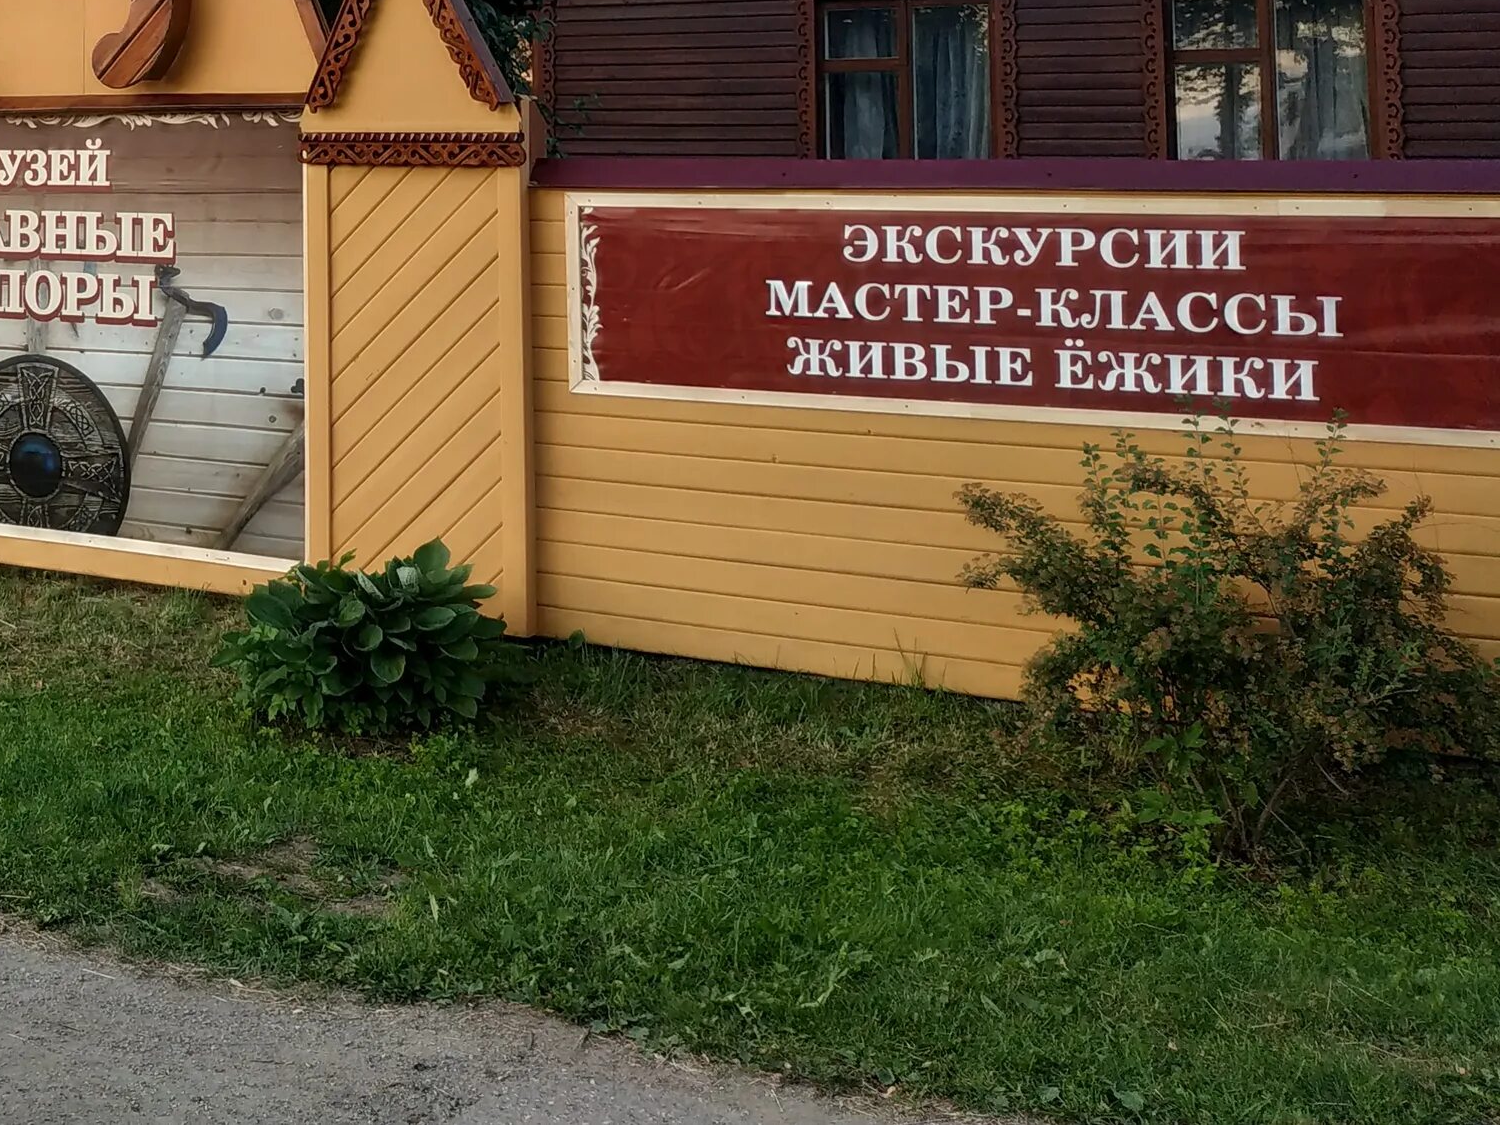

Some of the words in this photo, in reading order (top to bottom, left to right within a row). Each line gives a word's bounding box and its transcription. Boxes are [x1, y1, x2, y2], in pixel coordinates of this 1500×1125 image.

[842, 224, 1246, 272] ЭКСКУРСИИ
[765, 279, 1344, 338] МАСТЕР-КЛАССЫ
[786, 336, 1033, 388] ЖИВЫЕ
[1054, 338, 1320, 402] ЁЖИКИ
